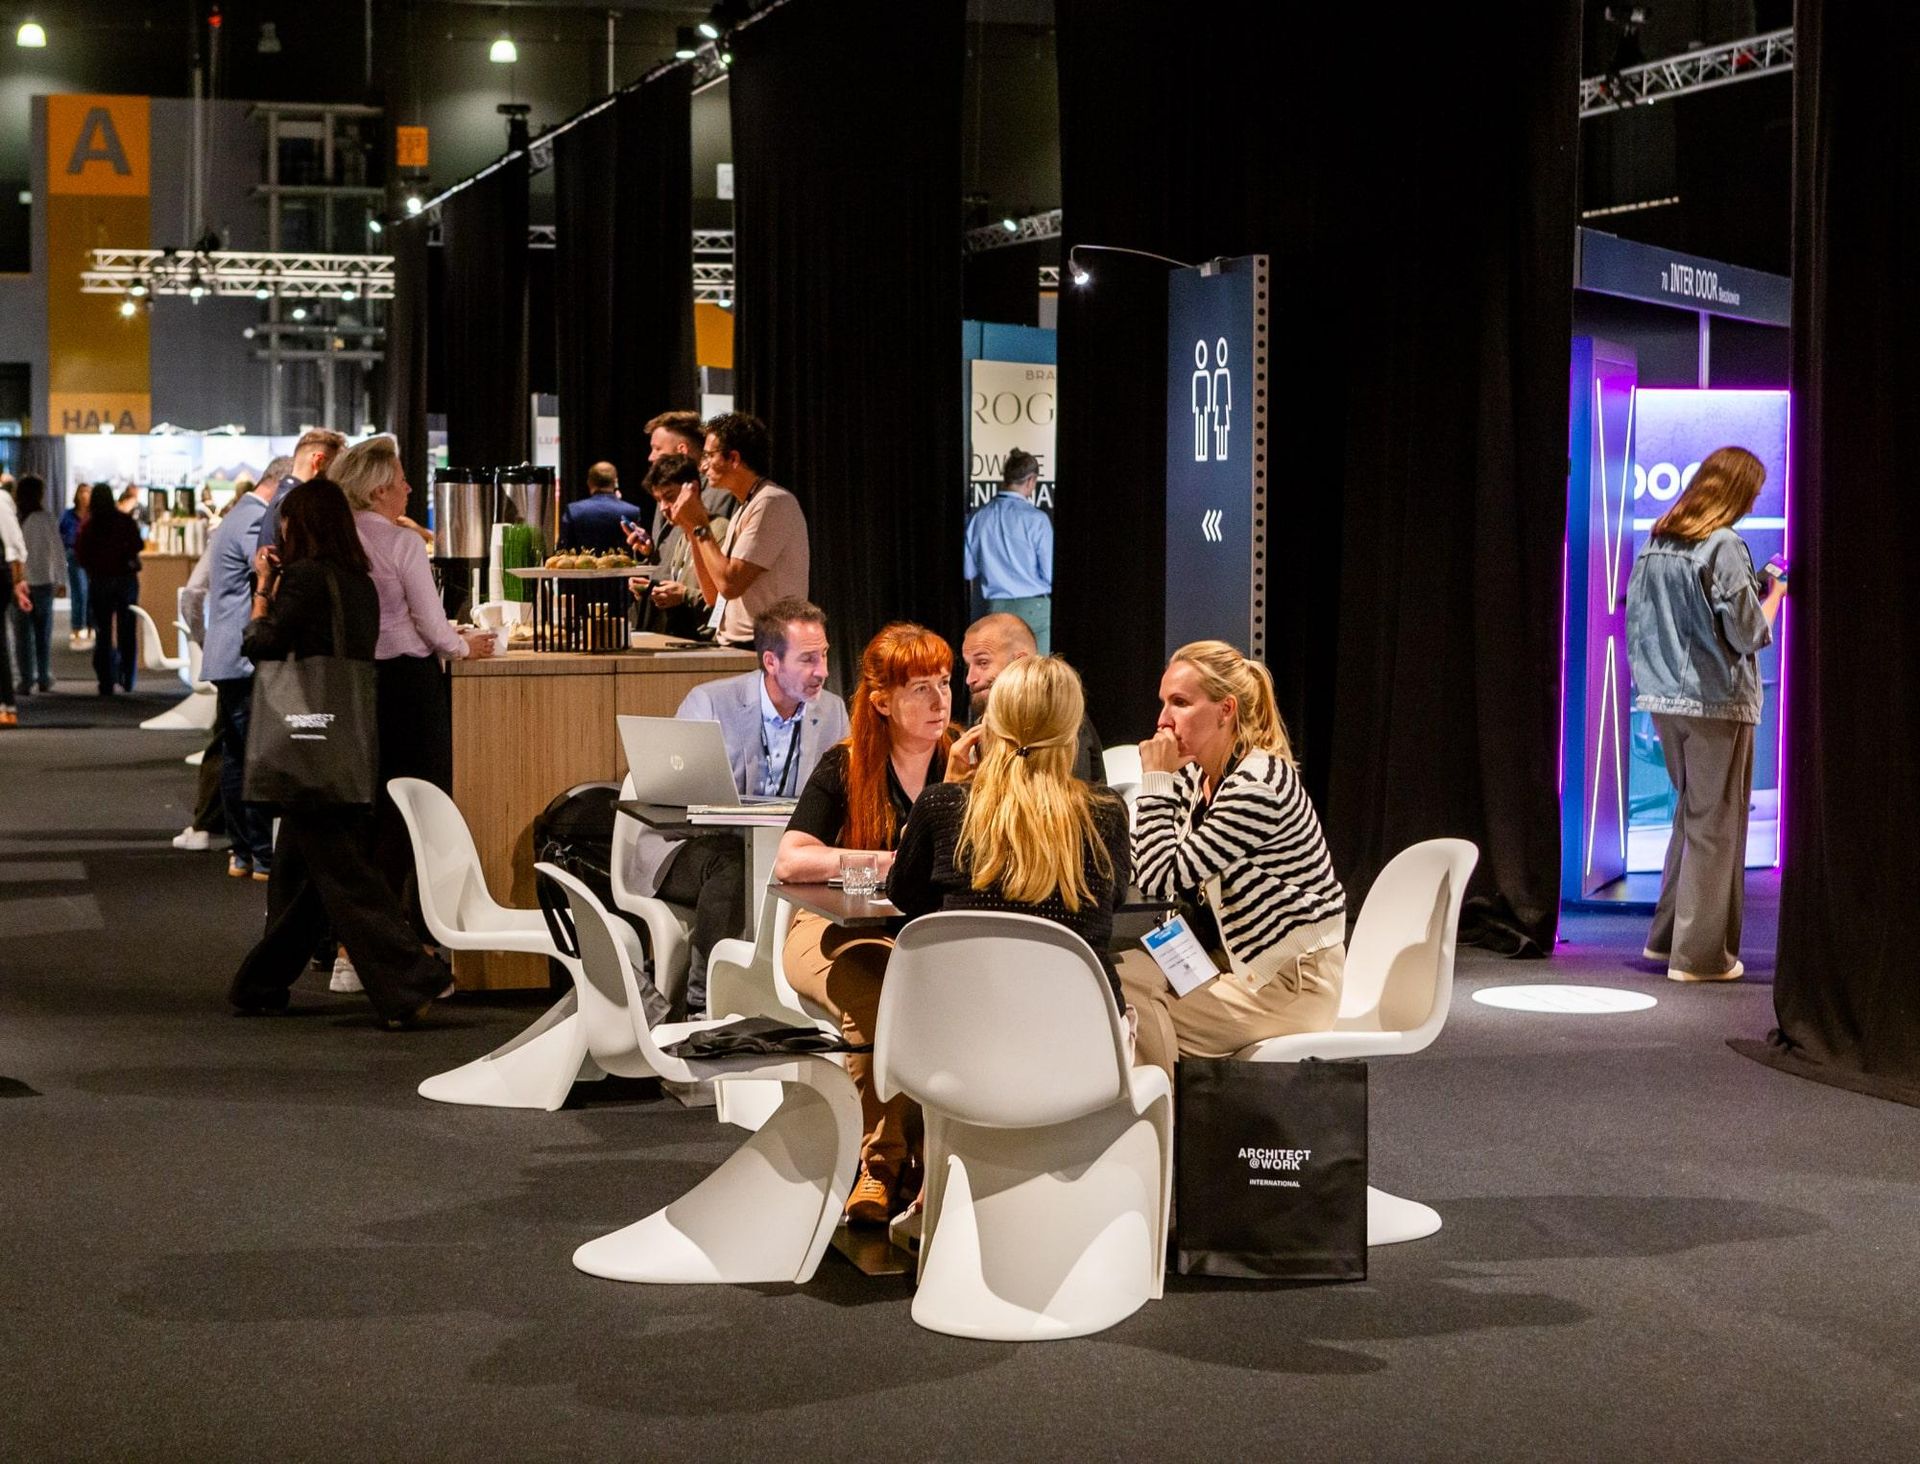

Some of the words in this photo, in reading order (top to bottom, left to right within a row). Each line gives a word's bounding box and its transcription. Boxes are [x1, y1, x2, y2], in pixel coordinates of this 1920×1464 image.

[66, 106, 132, 175] A
[1670, 262, 1694, 296] INTER
[1696, 268, 1718, 300] DOOR
[1025, 369, 1055, 381] BRA
[1238, 1147, 1311, 1161] ARCHITECT
[1249, 1158, 1300, 1171] @WORK
[1249, 1179, 1301, 1188] INTERNATIONAL
